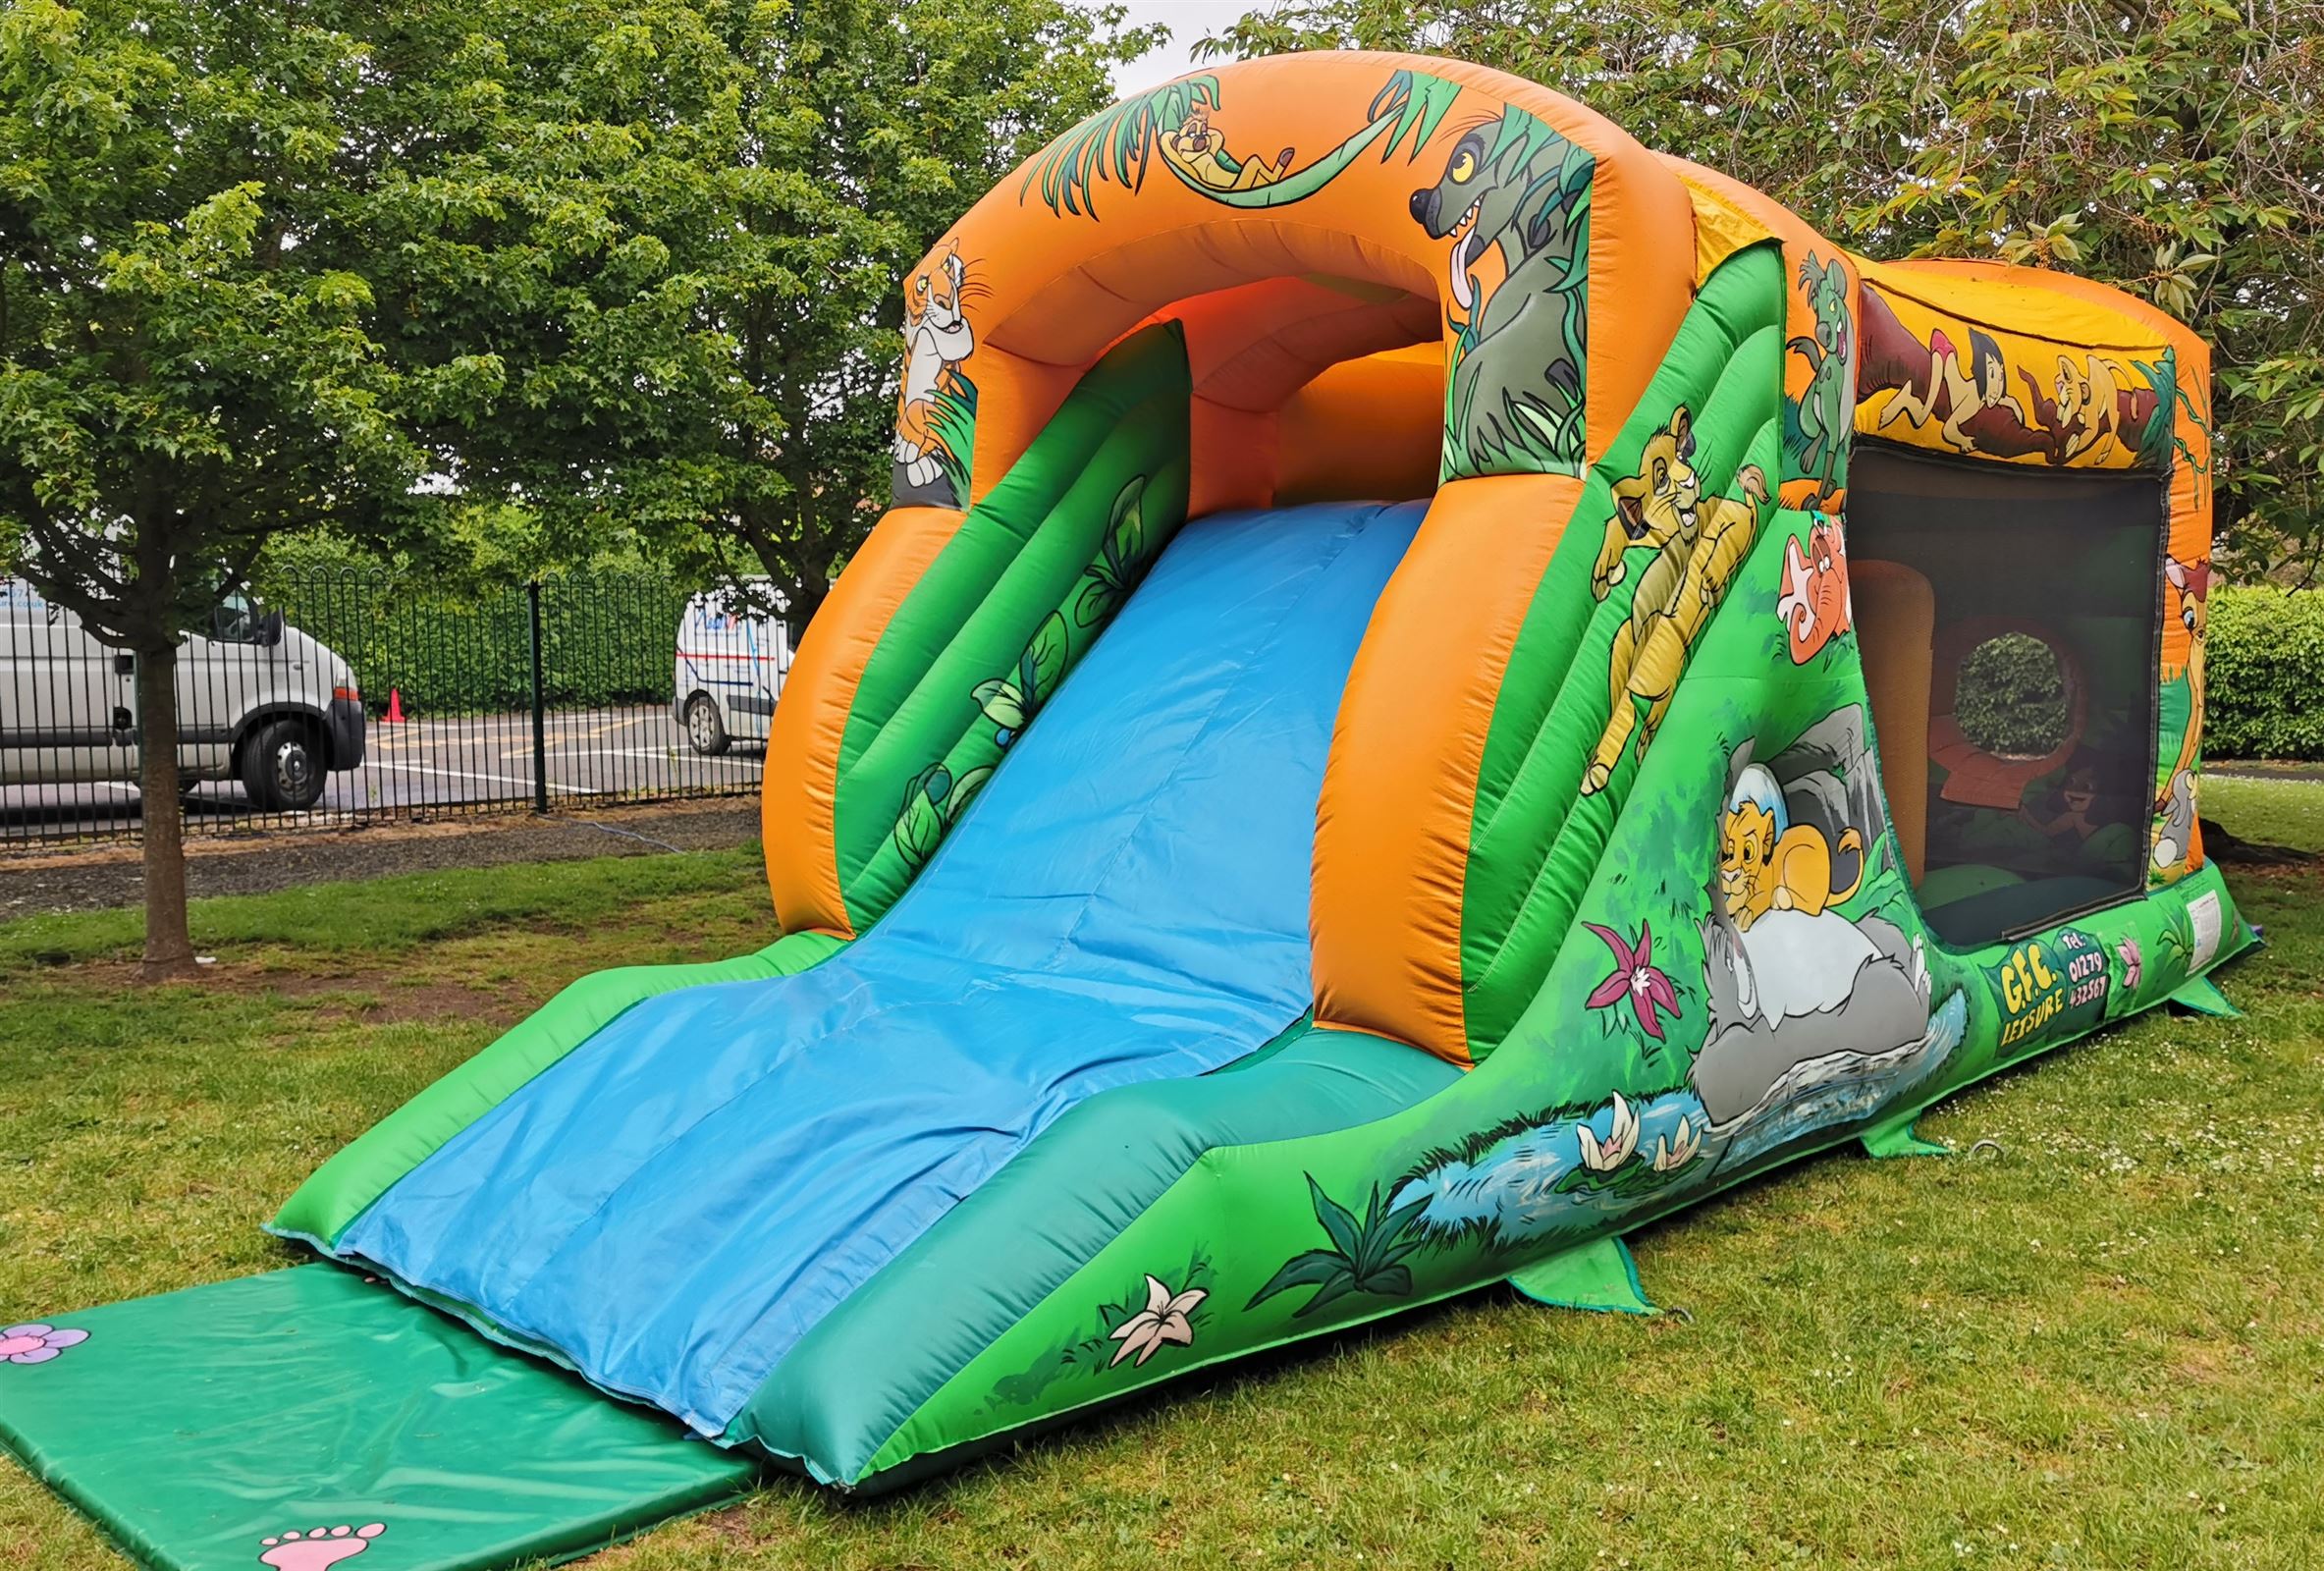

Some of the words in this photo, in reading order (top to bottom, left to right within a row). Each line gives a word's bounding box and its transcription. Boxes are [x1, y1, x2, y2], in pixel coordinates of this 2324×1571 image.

[2001, 944, 2057, 1014] G.F.C.
[2069, 951, 2103, 984] 01279
[2070, 975, 2107, 1009] 432567
[2001, 988, 2064, 1047] LEISURE
